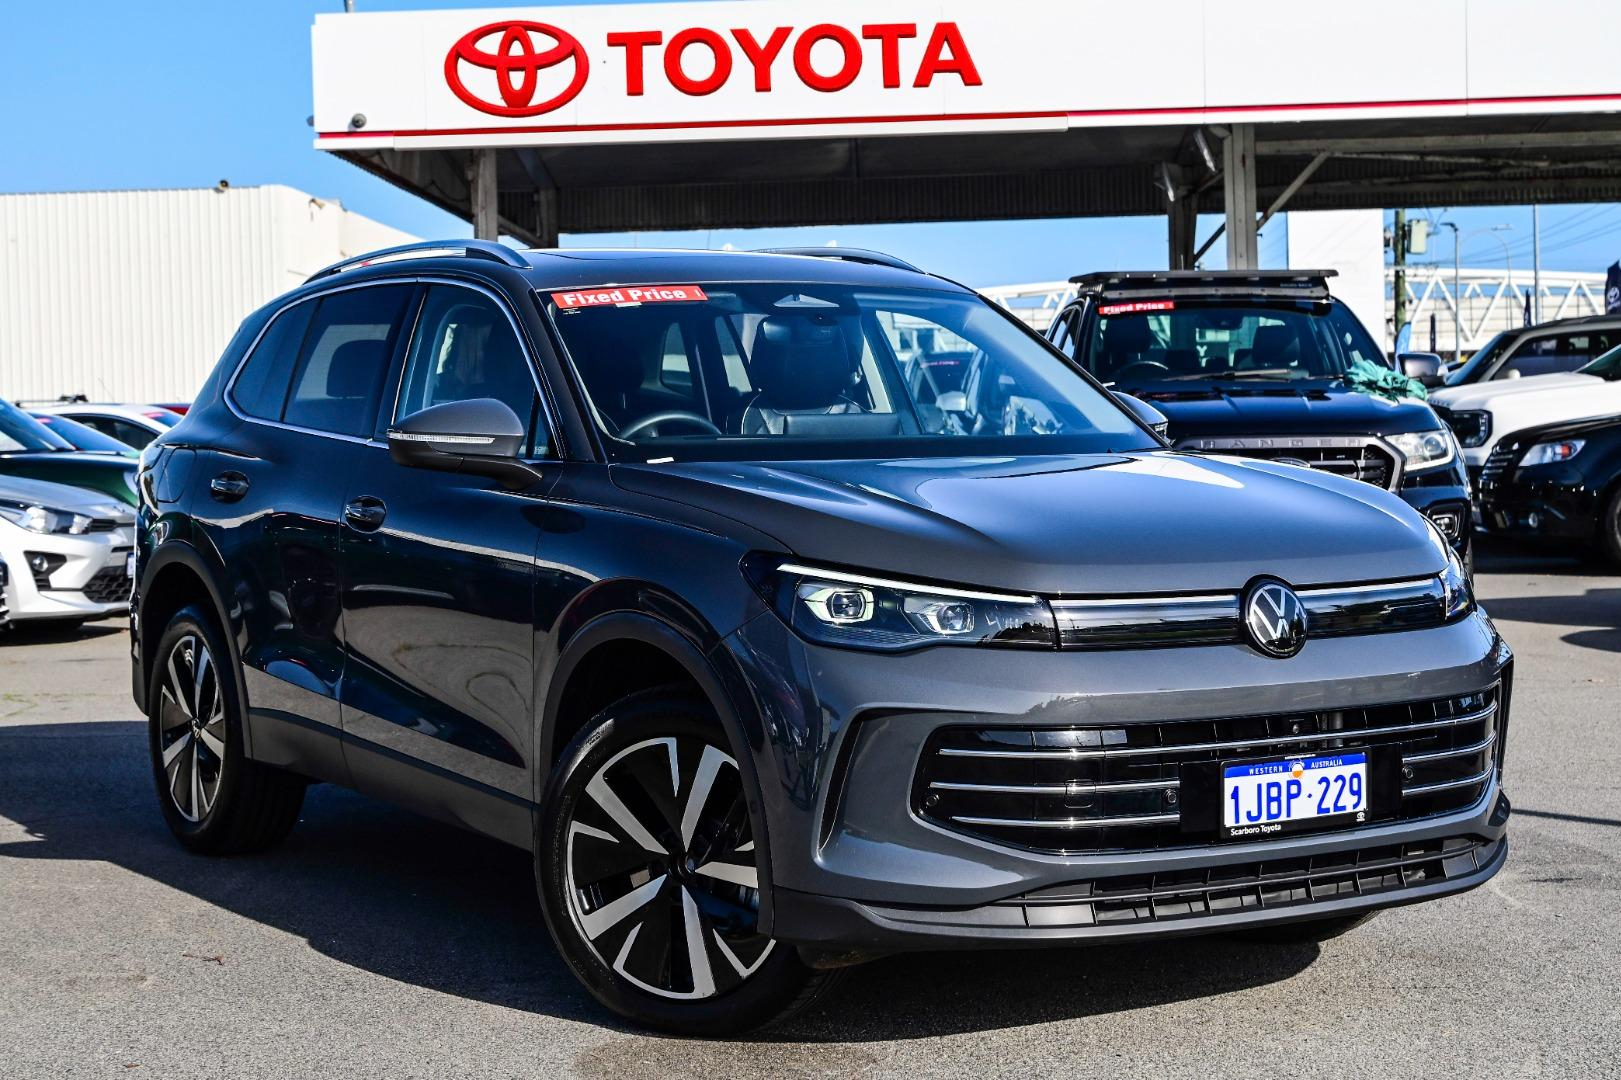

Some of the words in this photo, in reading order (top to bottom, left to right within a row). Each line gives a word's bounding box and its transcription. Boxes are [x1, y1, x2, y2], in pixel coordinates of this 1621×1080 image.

[607, 22, 982, 96] TOYOTA
[562, 290, 625, 306] Fixed
[626, 288, 687, 301] Price
[1103, 304, 1134, 314] Fixed
[1135, 302, 1165, 310] Price
[1200, 437, 1362, 449] RANGER
[1249, 765, 1283, 775] WESTERN
[1311, 759, 1343, 769] AUSTRALIA
[1230, 827, 1260, 836] Scarboro
[1260, 824, 1282, 834] Toyota
